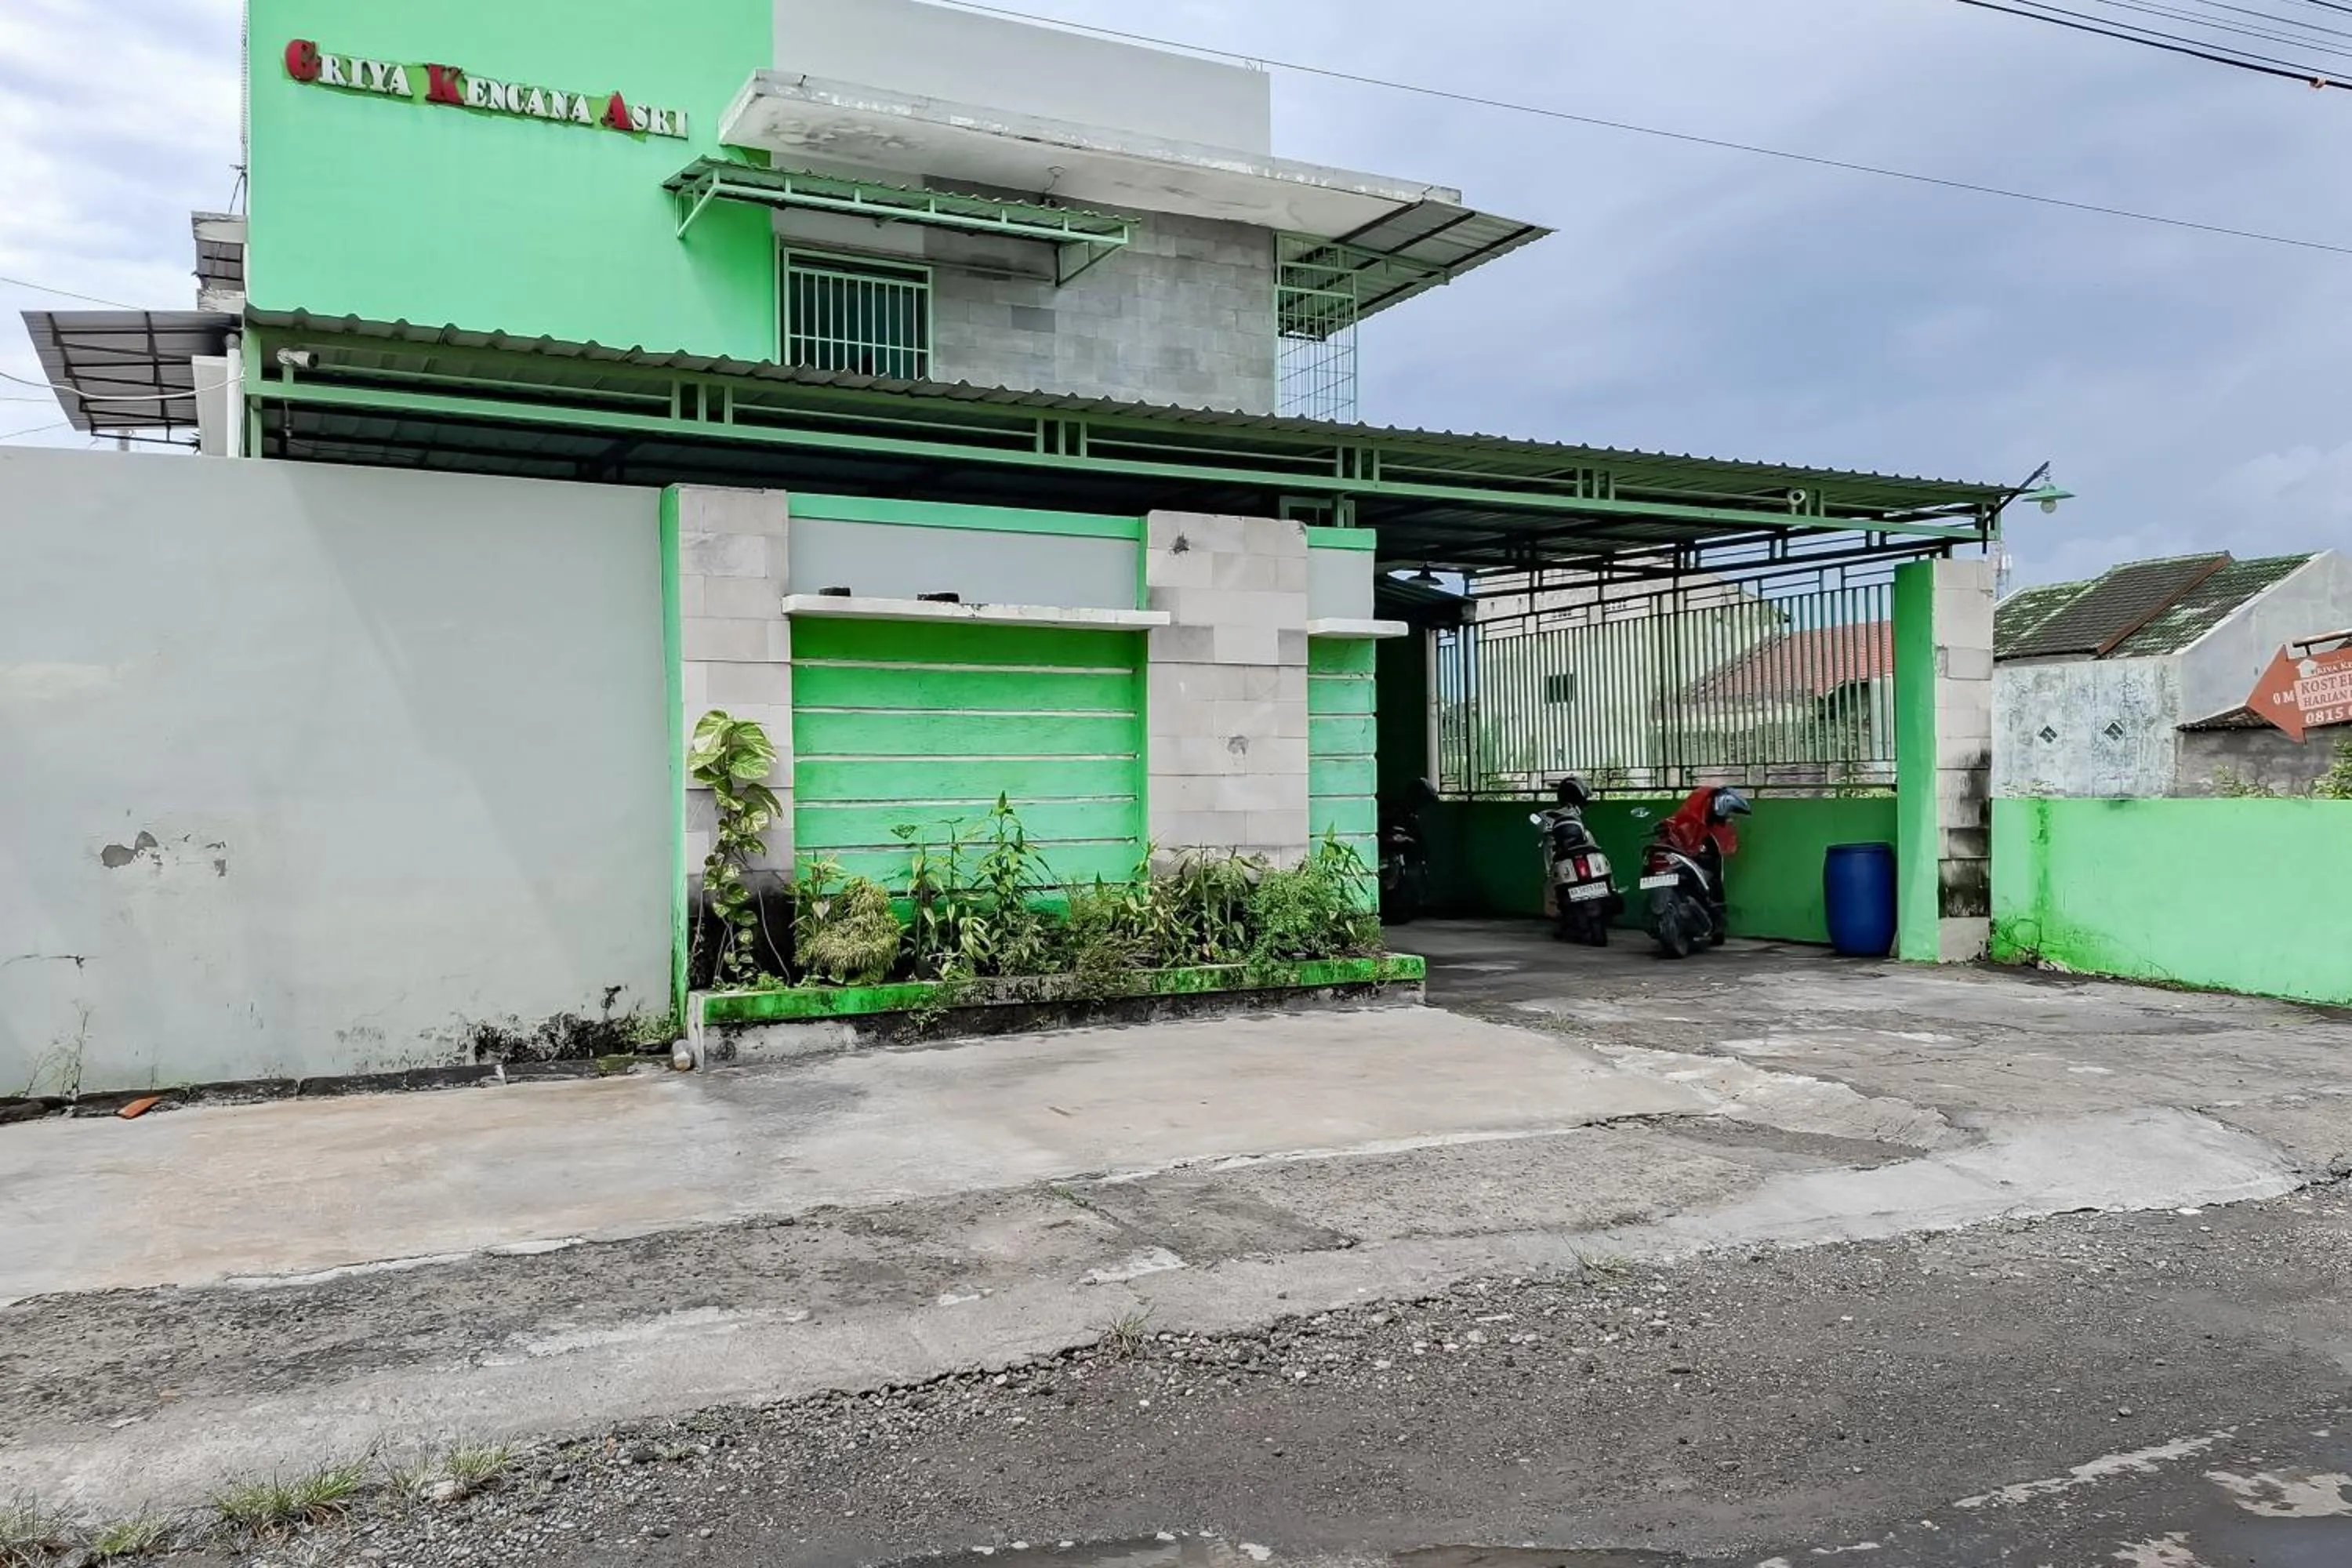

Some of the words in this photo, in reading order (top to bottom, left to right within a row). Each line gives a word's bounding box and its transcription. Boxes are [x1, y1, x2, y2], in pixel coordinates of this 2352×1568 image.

[285, 39, 412, 96] GRIYA
[426, 64, 593, 125] KENCANA
[601, 91, 689, 140] ASRI
[2304, 689, 2348, 706] HARIAN
[2306, 706, 2344, 724] 0815
